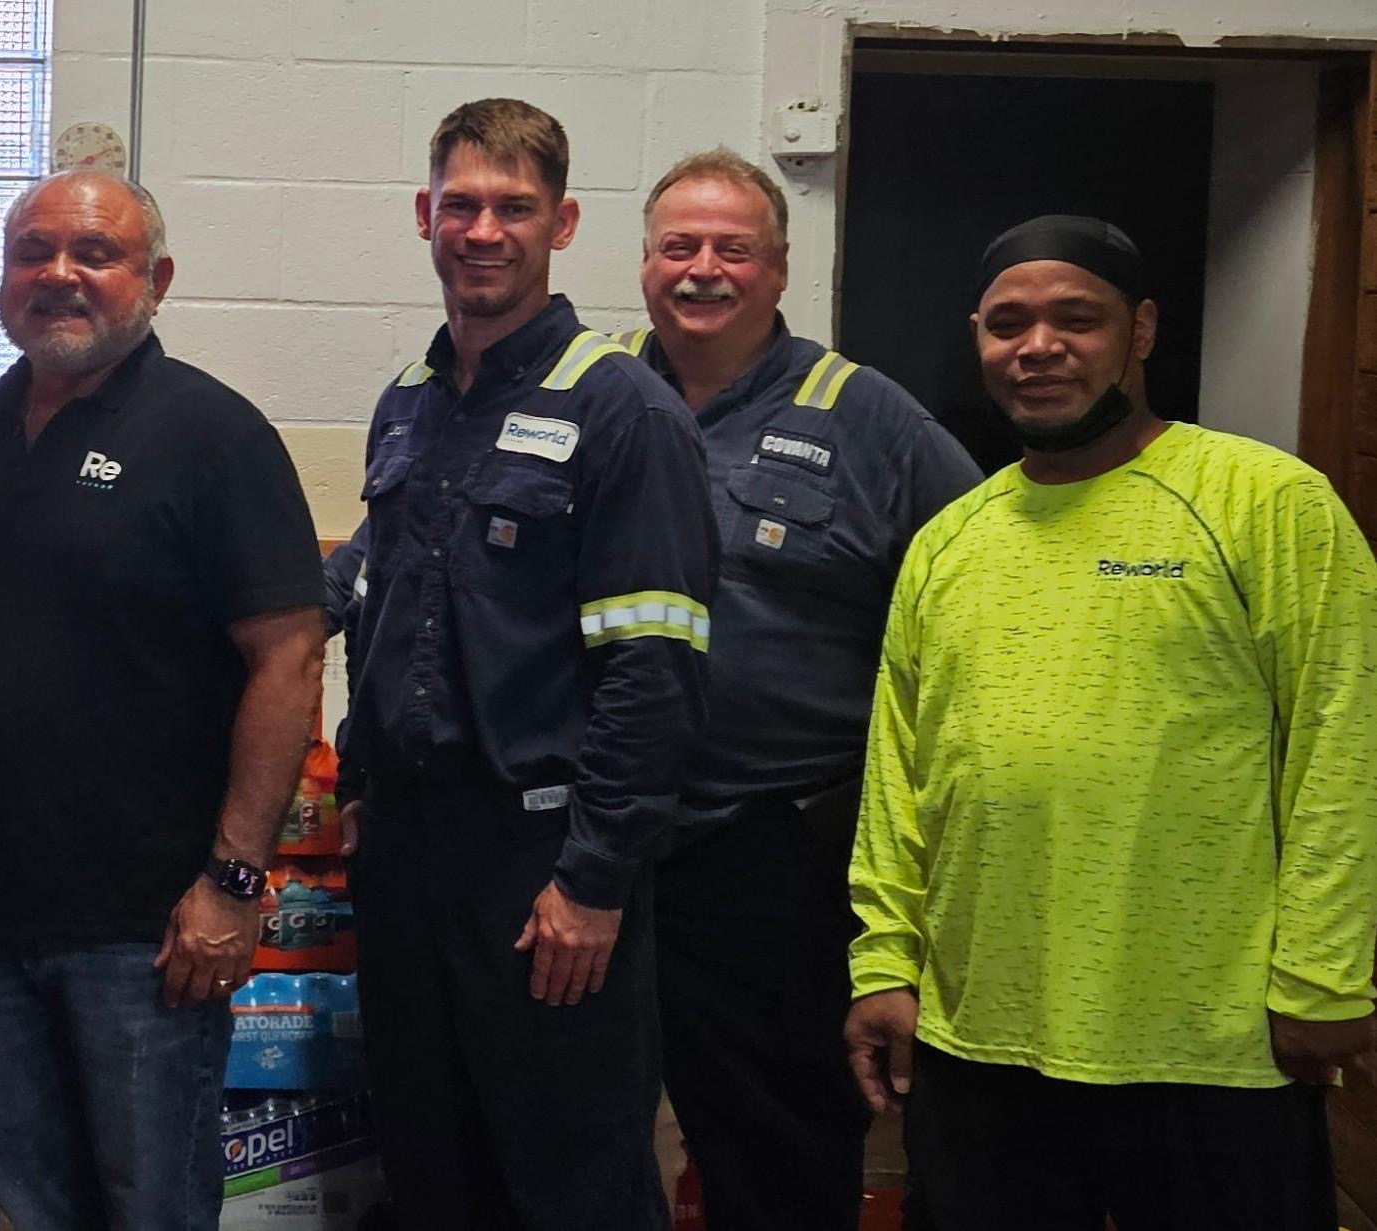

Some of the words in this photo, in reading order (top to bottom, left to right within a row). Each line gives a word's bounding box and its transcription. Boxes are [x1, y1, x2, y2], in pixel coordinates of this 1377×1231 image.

[505, 421, 569, 447] Reworld
[760, 435, 832, 468] COVANTA
[79, 450, 122, 481] Re
[1097, 559, 1186, 579] Reworld
[289, 913, 306, 928] G
[235, 1015, 314, 1030] ATORADE
[222, 1119, 294, 1167] opel
